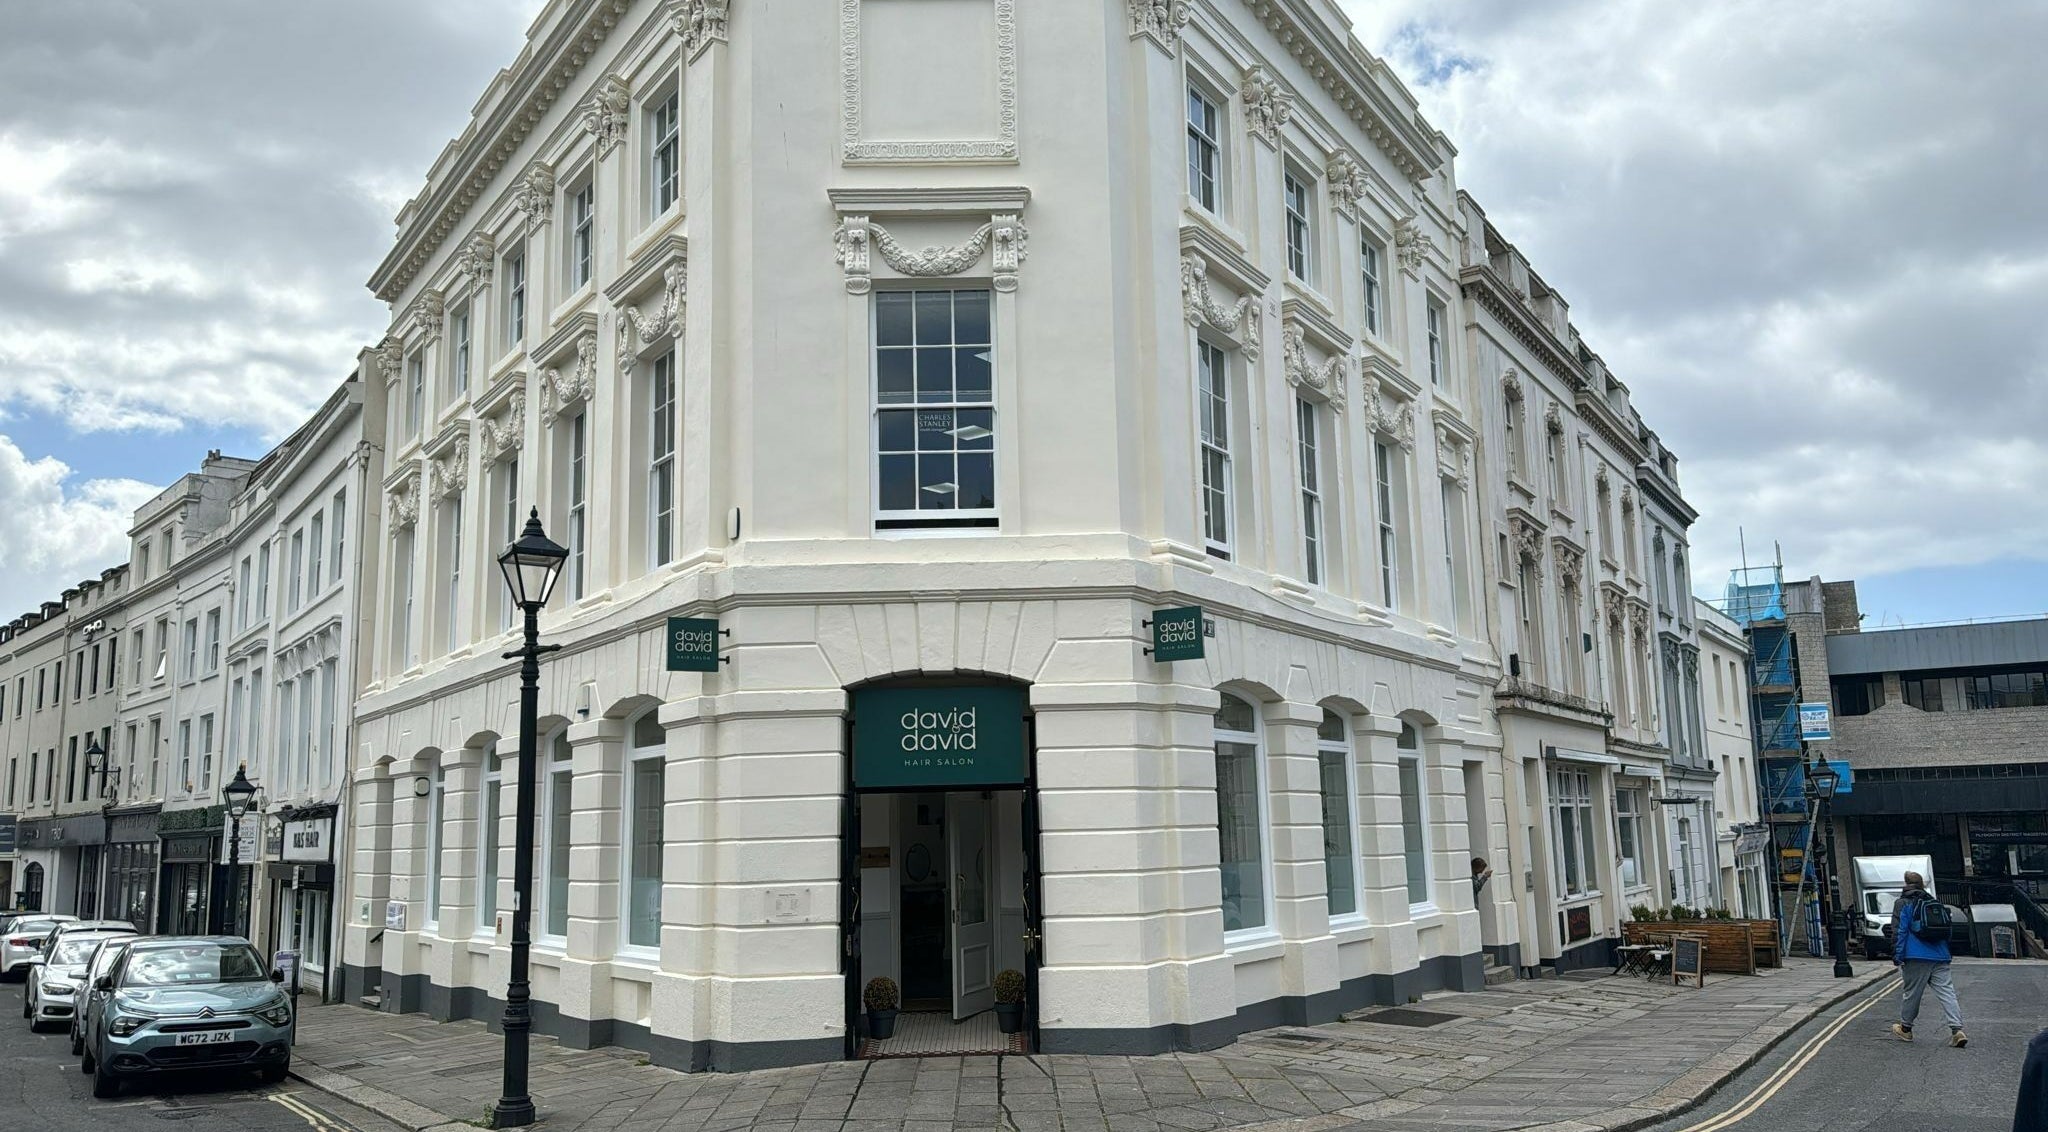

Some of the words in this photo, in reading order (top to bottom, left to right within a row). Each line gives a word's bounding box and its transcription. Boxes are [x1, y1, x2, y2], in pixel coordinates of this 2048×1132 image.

[919, 420, 951, 428] STANLEY
[1160, 617, 1195, 632] david
[675, 629, 713, 642] david
[1160, 629, 1196, 643] david
[675, 640, 713, 653] david
[901, 706, 976, 730] david
[901, 728, 976, 751] david
[904, 758, 931, 767] HAIR
[937, 757, 974, 766] SALON
[180, 1033, 208, 1044] WG72
[210, 1032, 231, 1042] JZK
